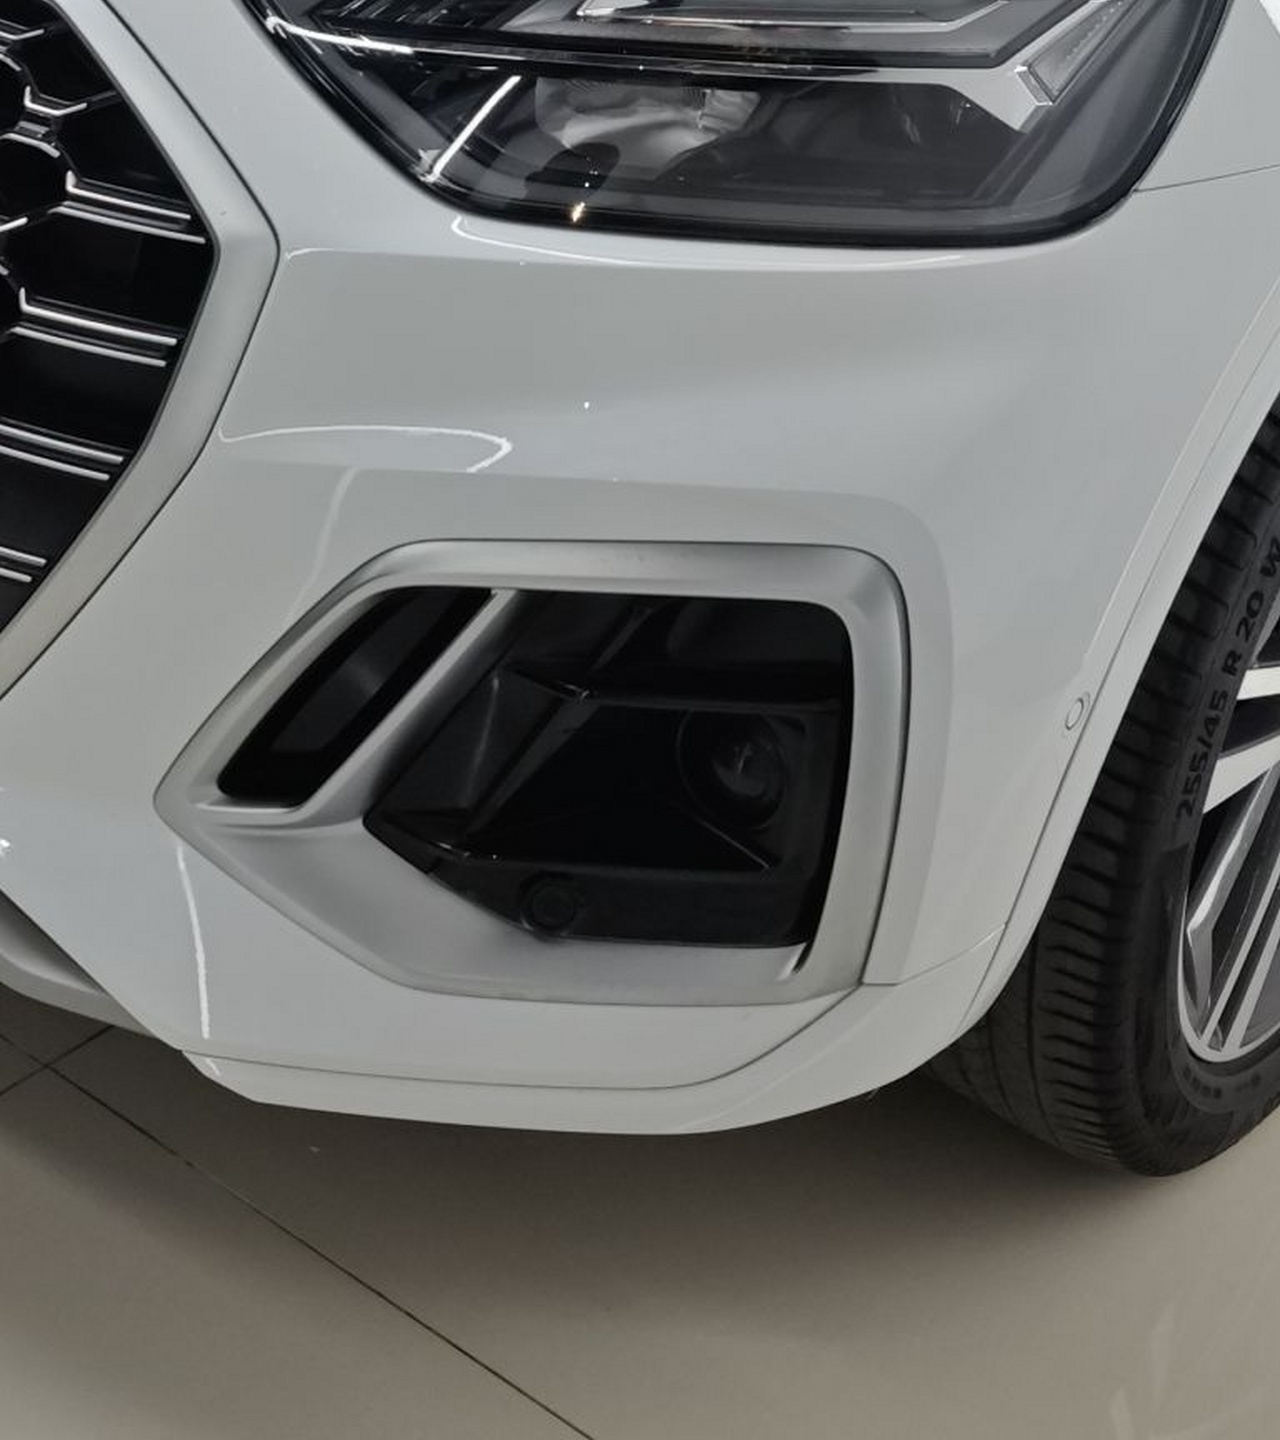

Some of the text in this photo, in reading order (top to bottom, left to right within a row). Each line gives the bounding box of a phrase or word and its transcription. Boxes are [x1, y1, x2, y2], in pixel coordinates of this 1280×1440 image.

[1178, 690, 1228, 817] 255/45
[1222, 649, 1243, 677] R
[1236, 590, 1264, 642] 20
